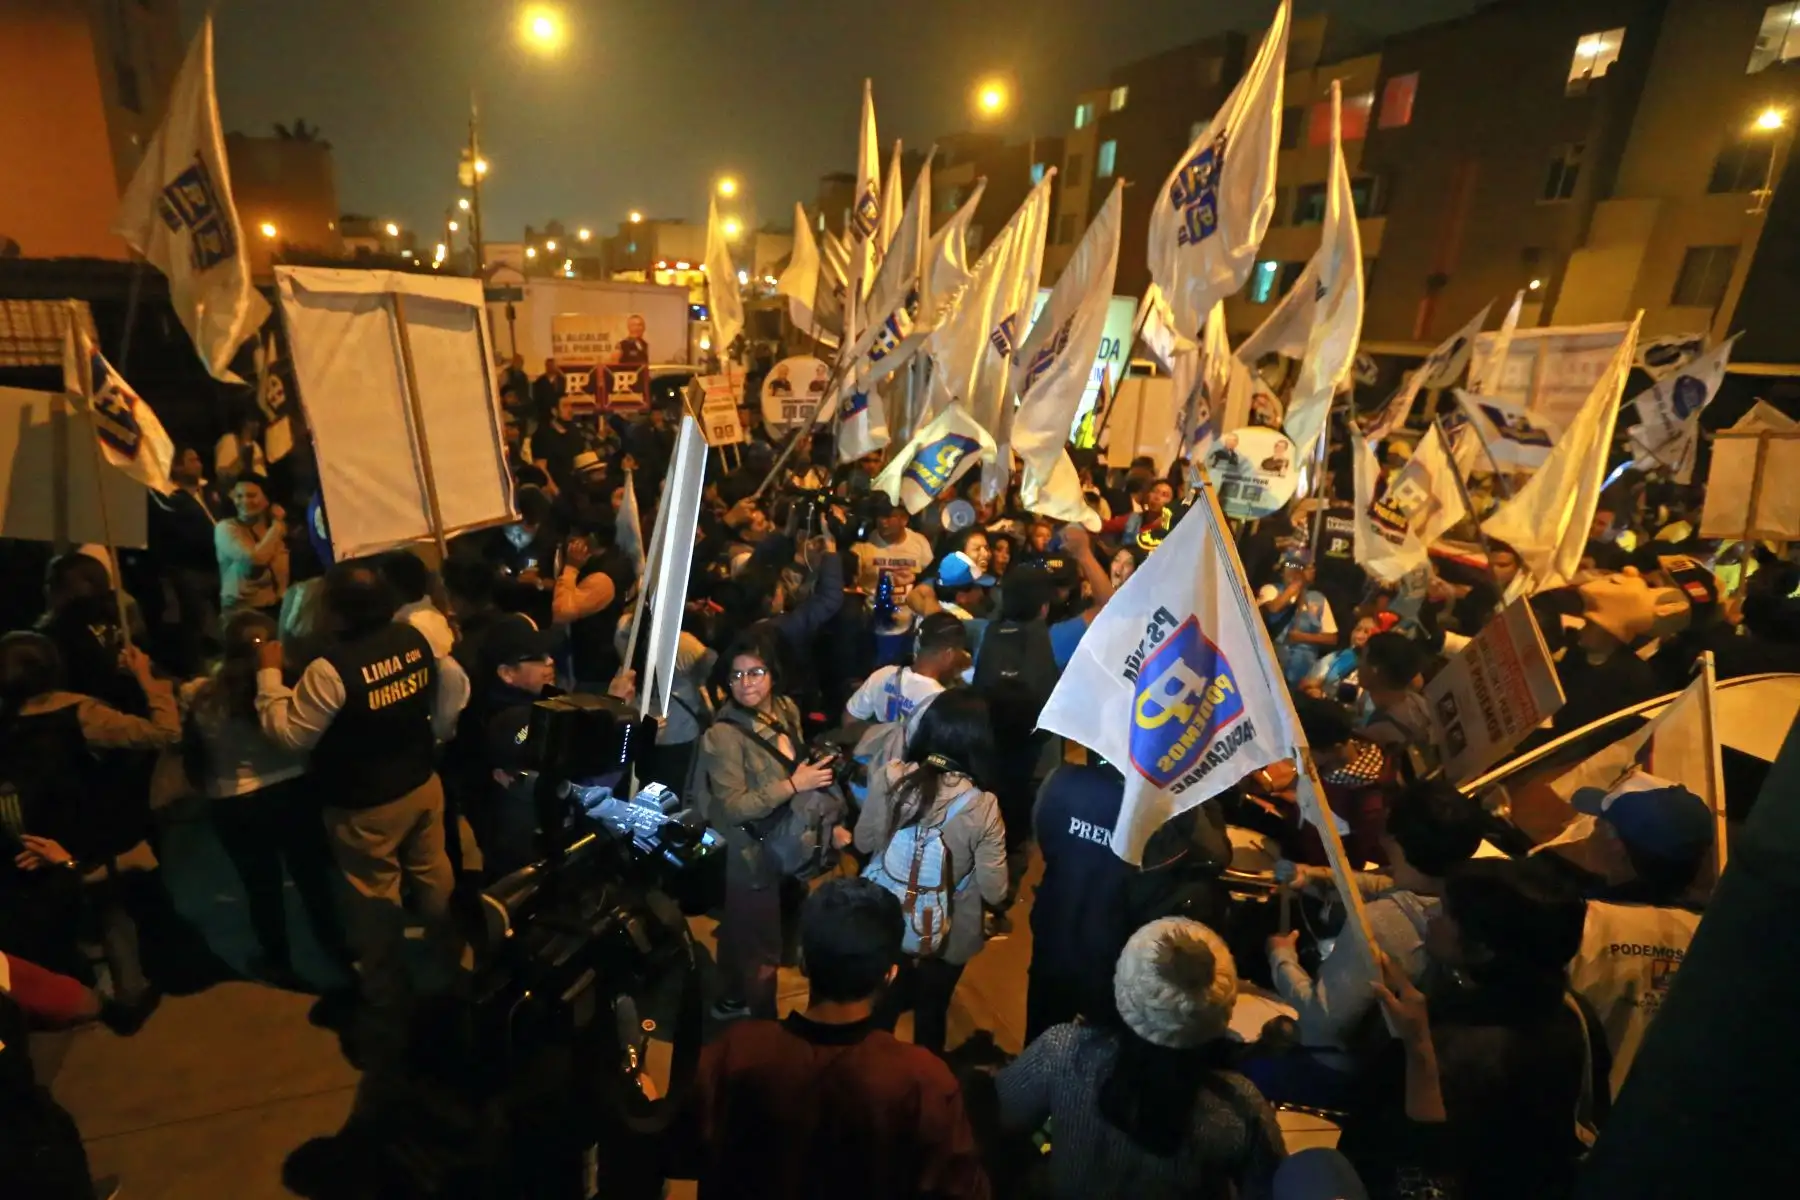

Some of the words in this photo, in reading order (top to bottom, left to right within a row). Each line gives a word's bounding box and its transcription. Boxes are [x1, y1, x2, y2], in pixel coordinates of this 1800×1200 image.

[361, 655, 404, 685] LIMA
[1068, 816, 1112, 848] PREN
[1610, 943, 1685, 962] PODEMOS
